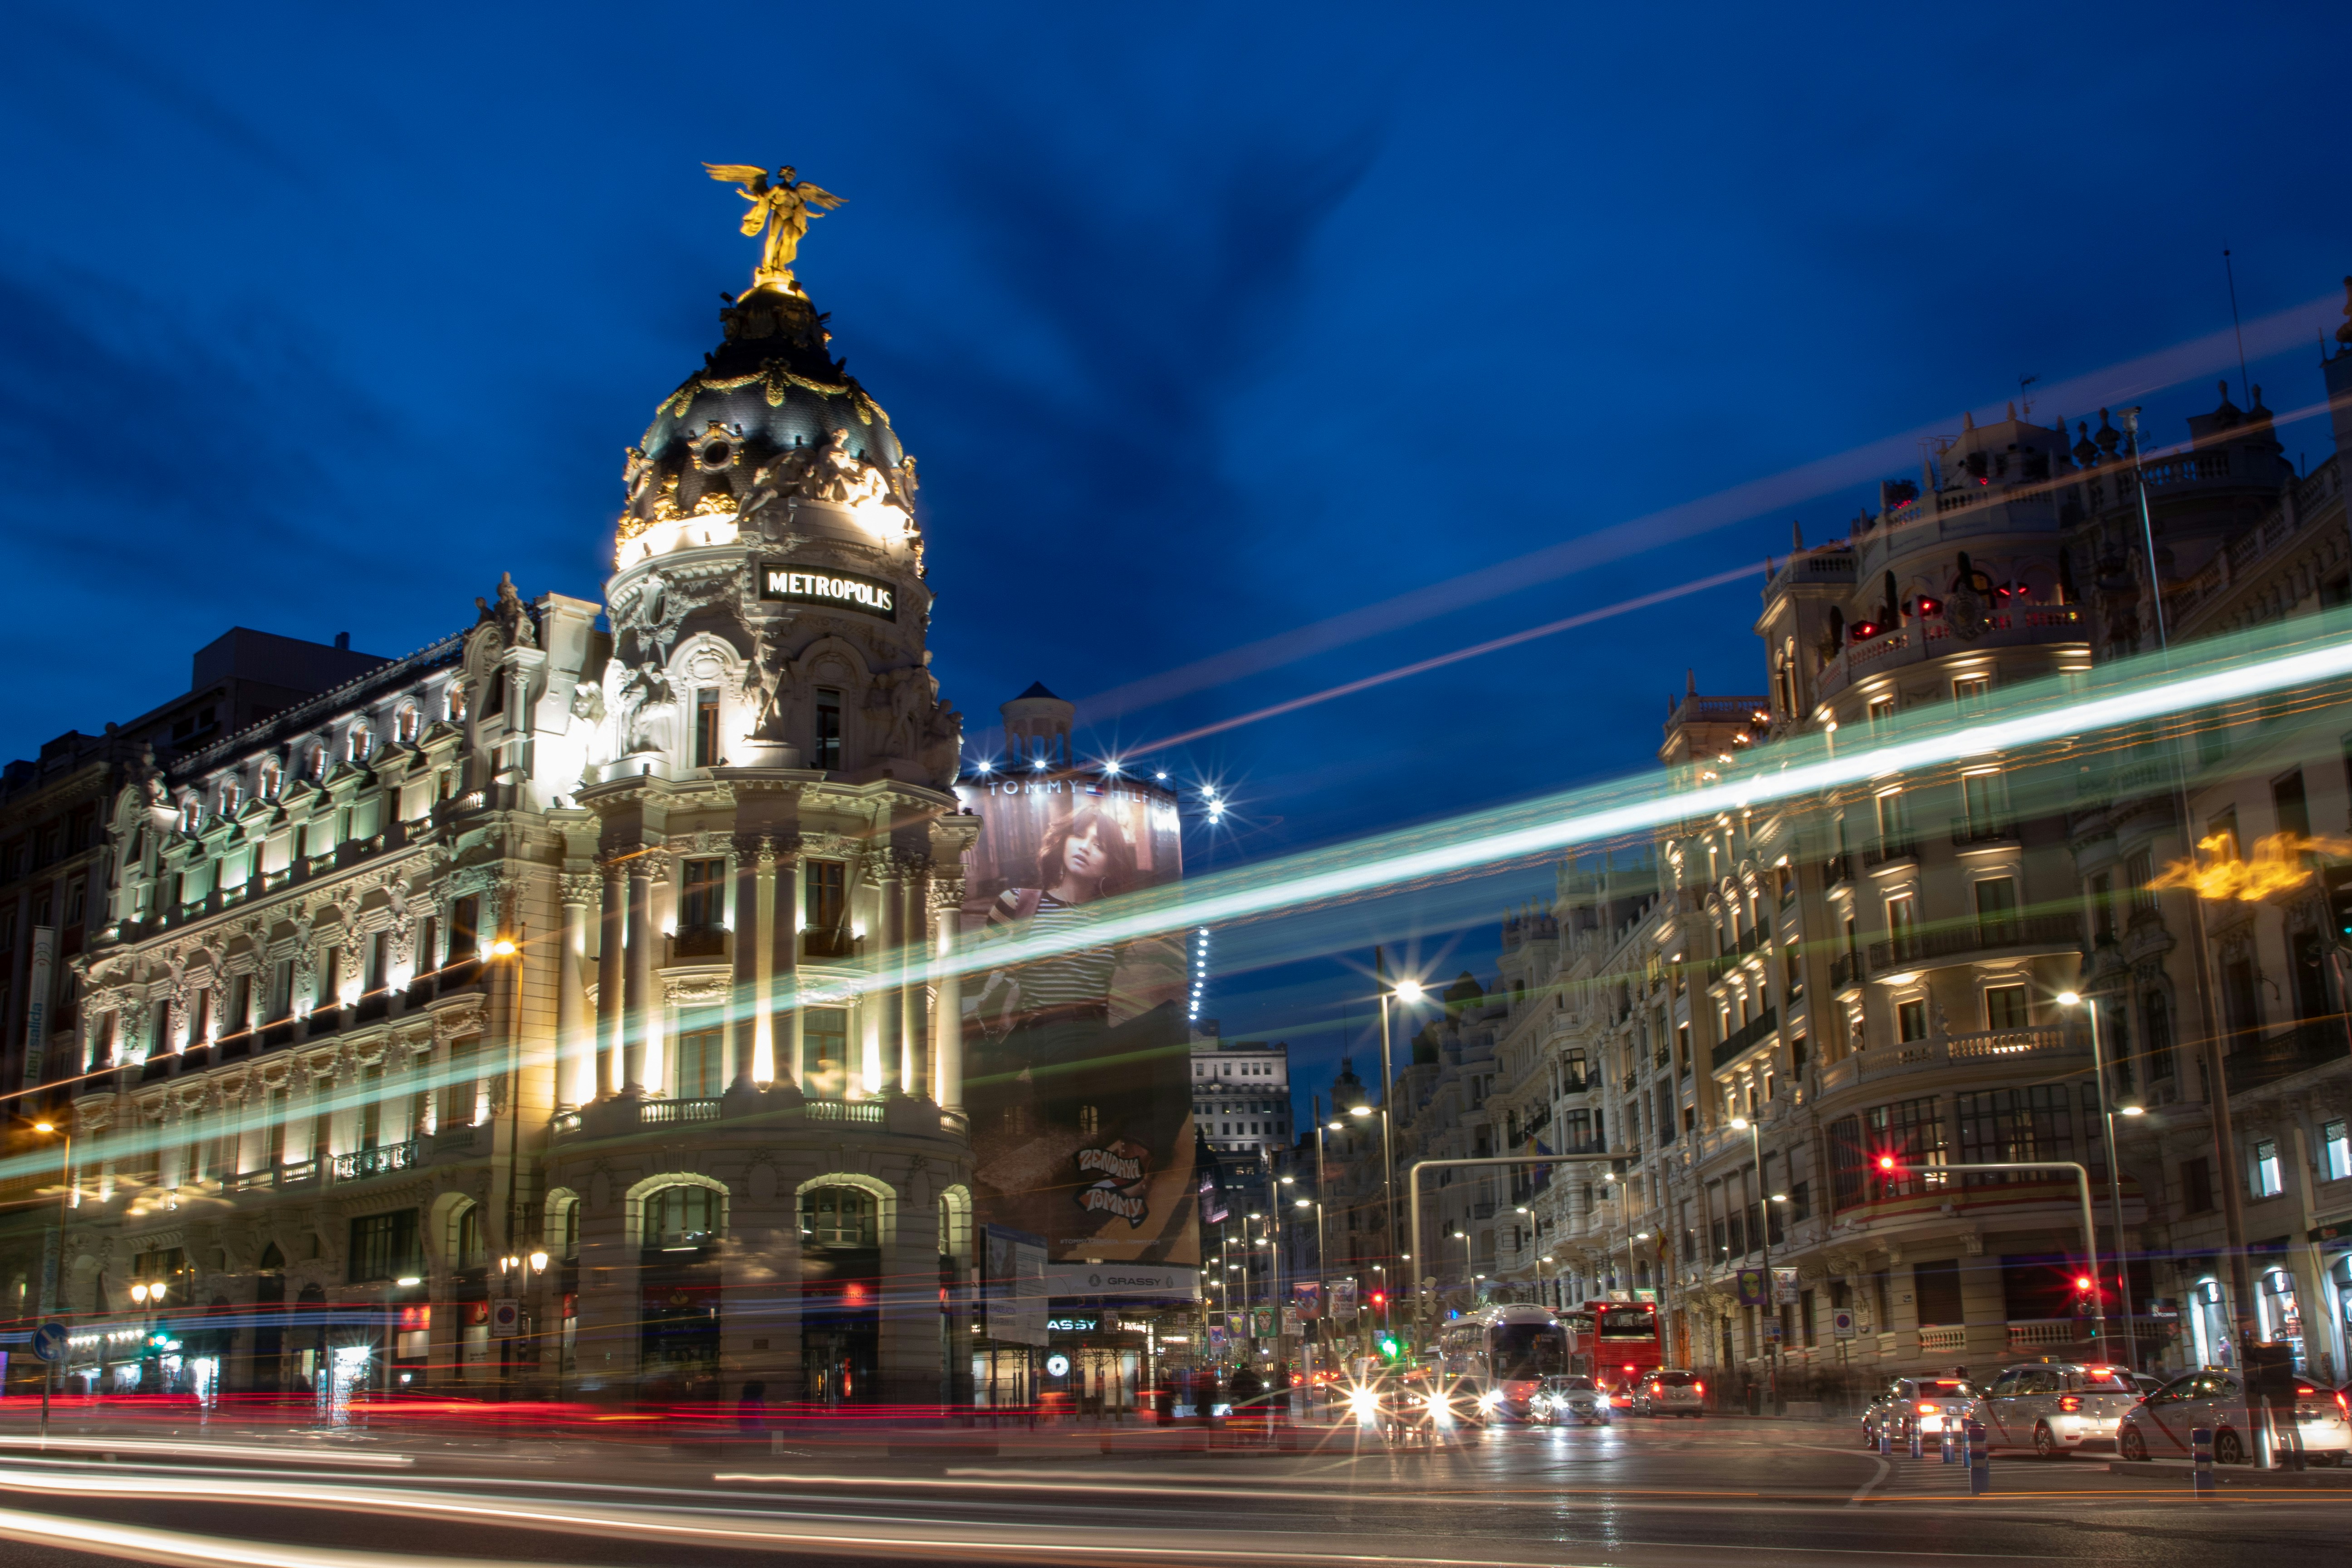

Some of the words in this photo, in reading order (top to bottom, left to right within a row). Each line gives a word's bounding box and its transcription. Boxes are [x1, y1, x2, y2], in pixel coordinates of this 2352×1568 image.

[769, 572, 892, 611] METROPOLIS
[987, 779, 1079, 796] TOMMY
[1111, 786, 1177, 812] HILFIGER
[29, 1002, 43, 1047] salida
[1079, 1149, 1141, 1179] ZENDAYA
[1086, 1188, 1143, 1218] TOMMY
[1107, 1277, 1161, 1286] GRASSY
[1047, 1319, 1097, 1330] ASSY
